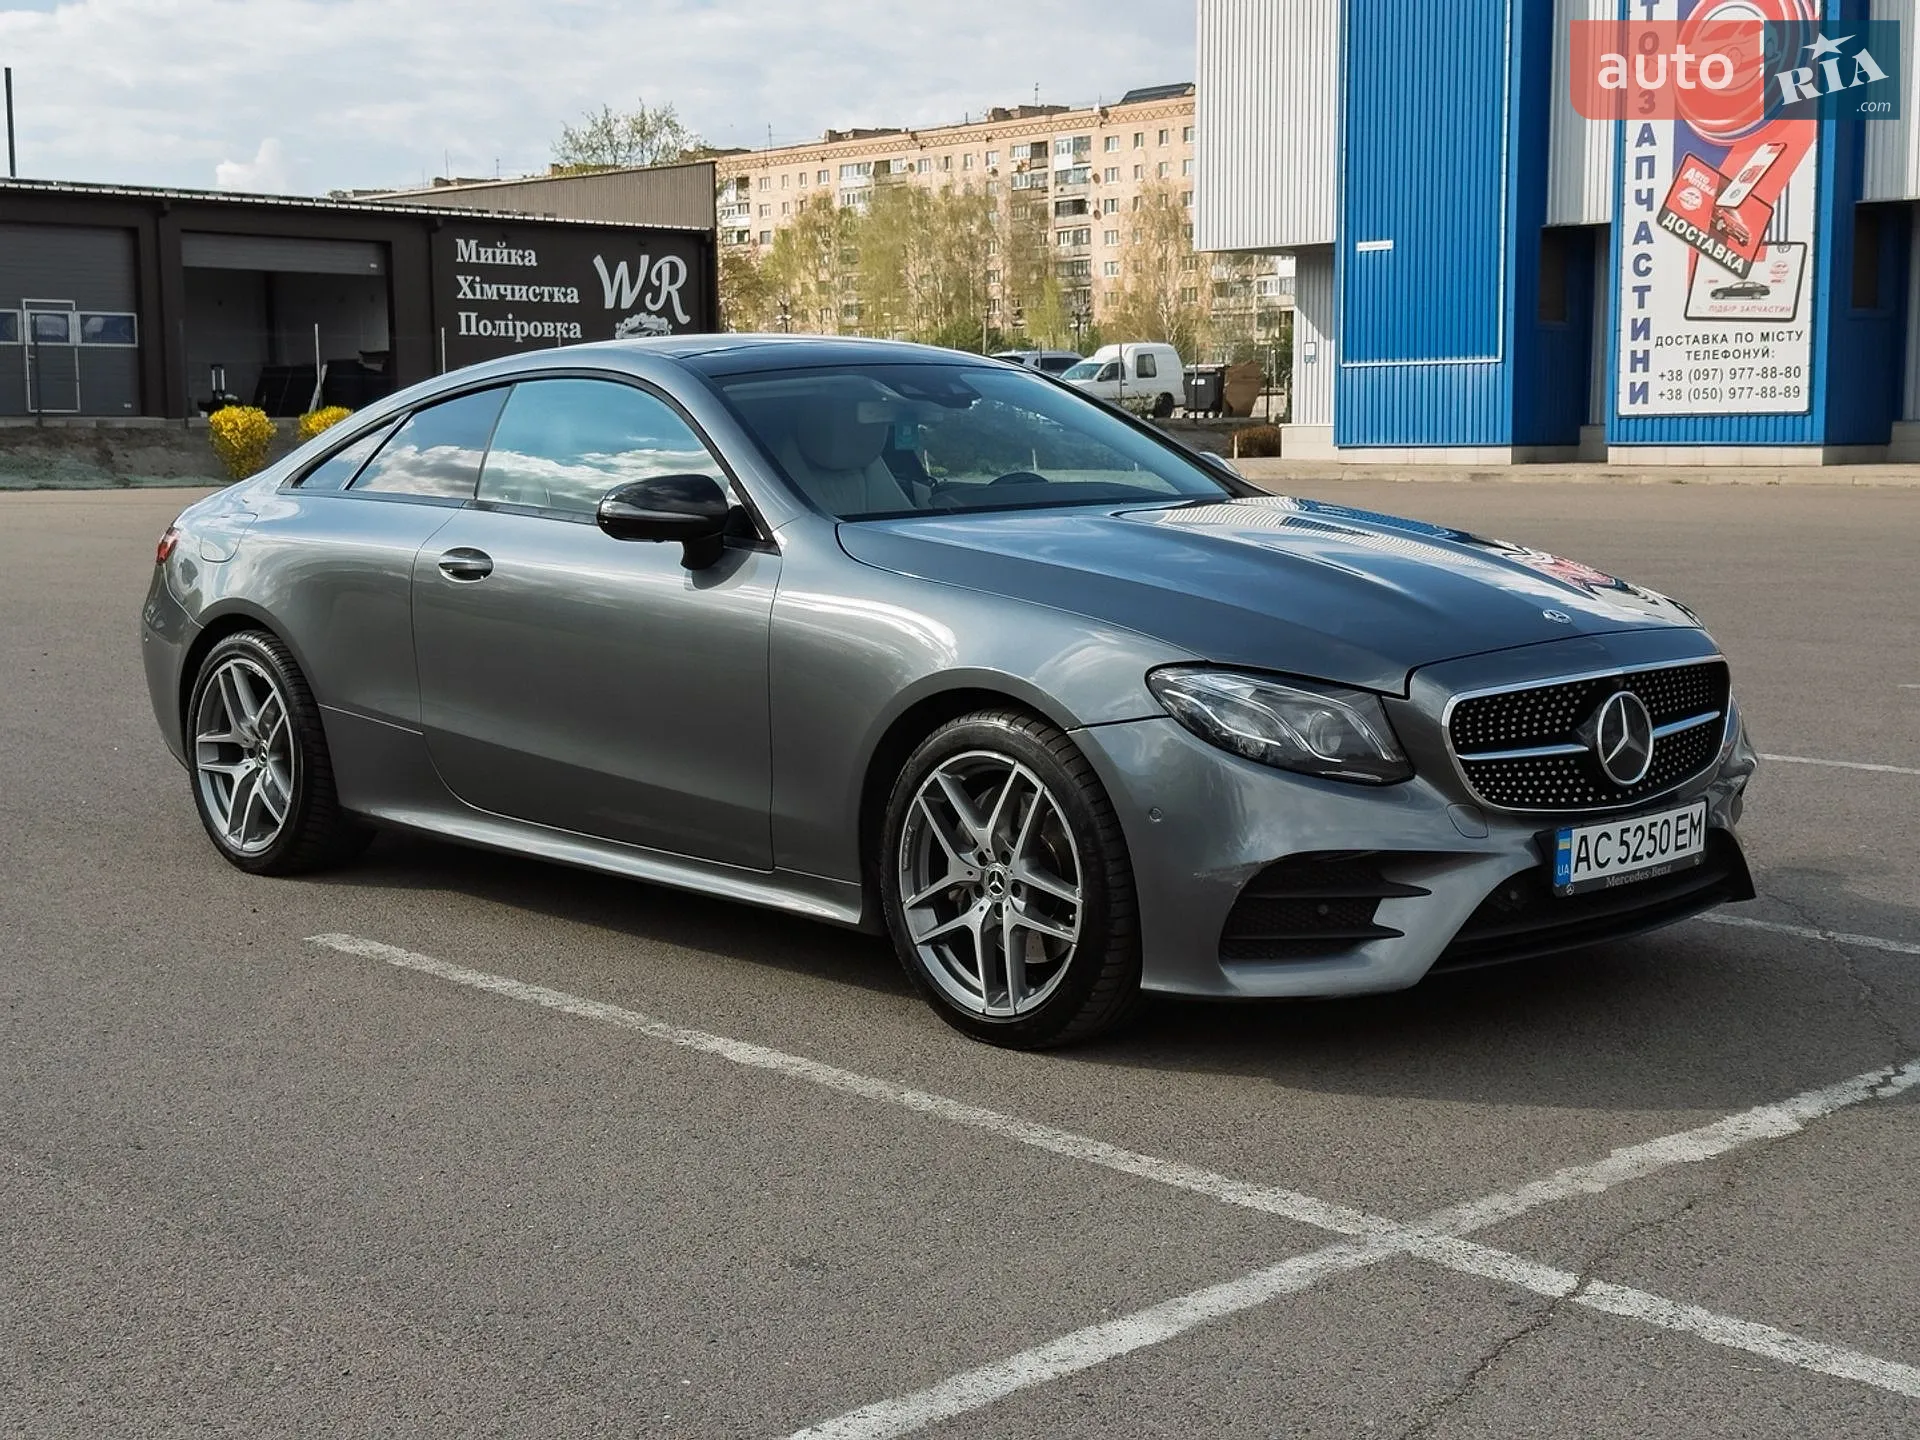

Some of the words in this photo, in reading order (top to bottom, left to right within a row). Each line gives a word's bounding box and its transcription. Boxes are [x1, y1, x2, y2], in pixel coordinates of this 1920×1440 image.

[455, 238, 538, 267] Мийка
[1661, 211, 1745, 273] ДОСТАВКА
[456, 275, 580, 304] Хімчистка
[592, 253, 691, 325] WR
[458, 312, 583, 343] Поліровка
[1655, 334, 1728, 348] ДОСТАВКА
[1734, 332, 1754, 343] ПО
[1760, 330, 1803, 342] МІСТУ
[1686, 346, 1775, 361] ТЕЛЕФОНУЙ:
[1658, 370, 1683, 382] +38
[1688, 368, 1724, 384] (097)
[1729, 366, 1801, 380] 977-88-80
[1658, 389, 1682, 401] +38
[1688, 387, 1723, 402] (050)
[1729, 385, 1800, 400] 977-88-89
[1574, 831, 1612, 873] AC
[1617, 818, 1670, 865] 5250
[1674, 809, 1703, 851] EM
[1557, 864, 1569, 876] UA
